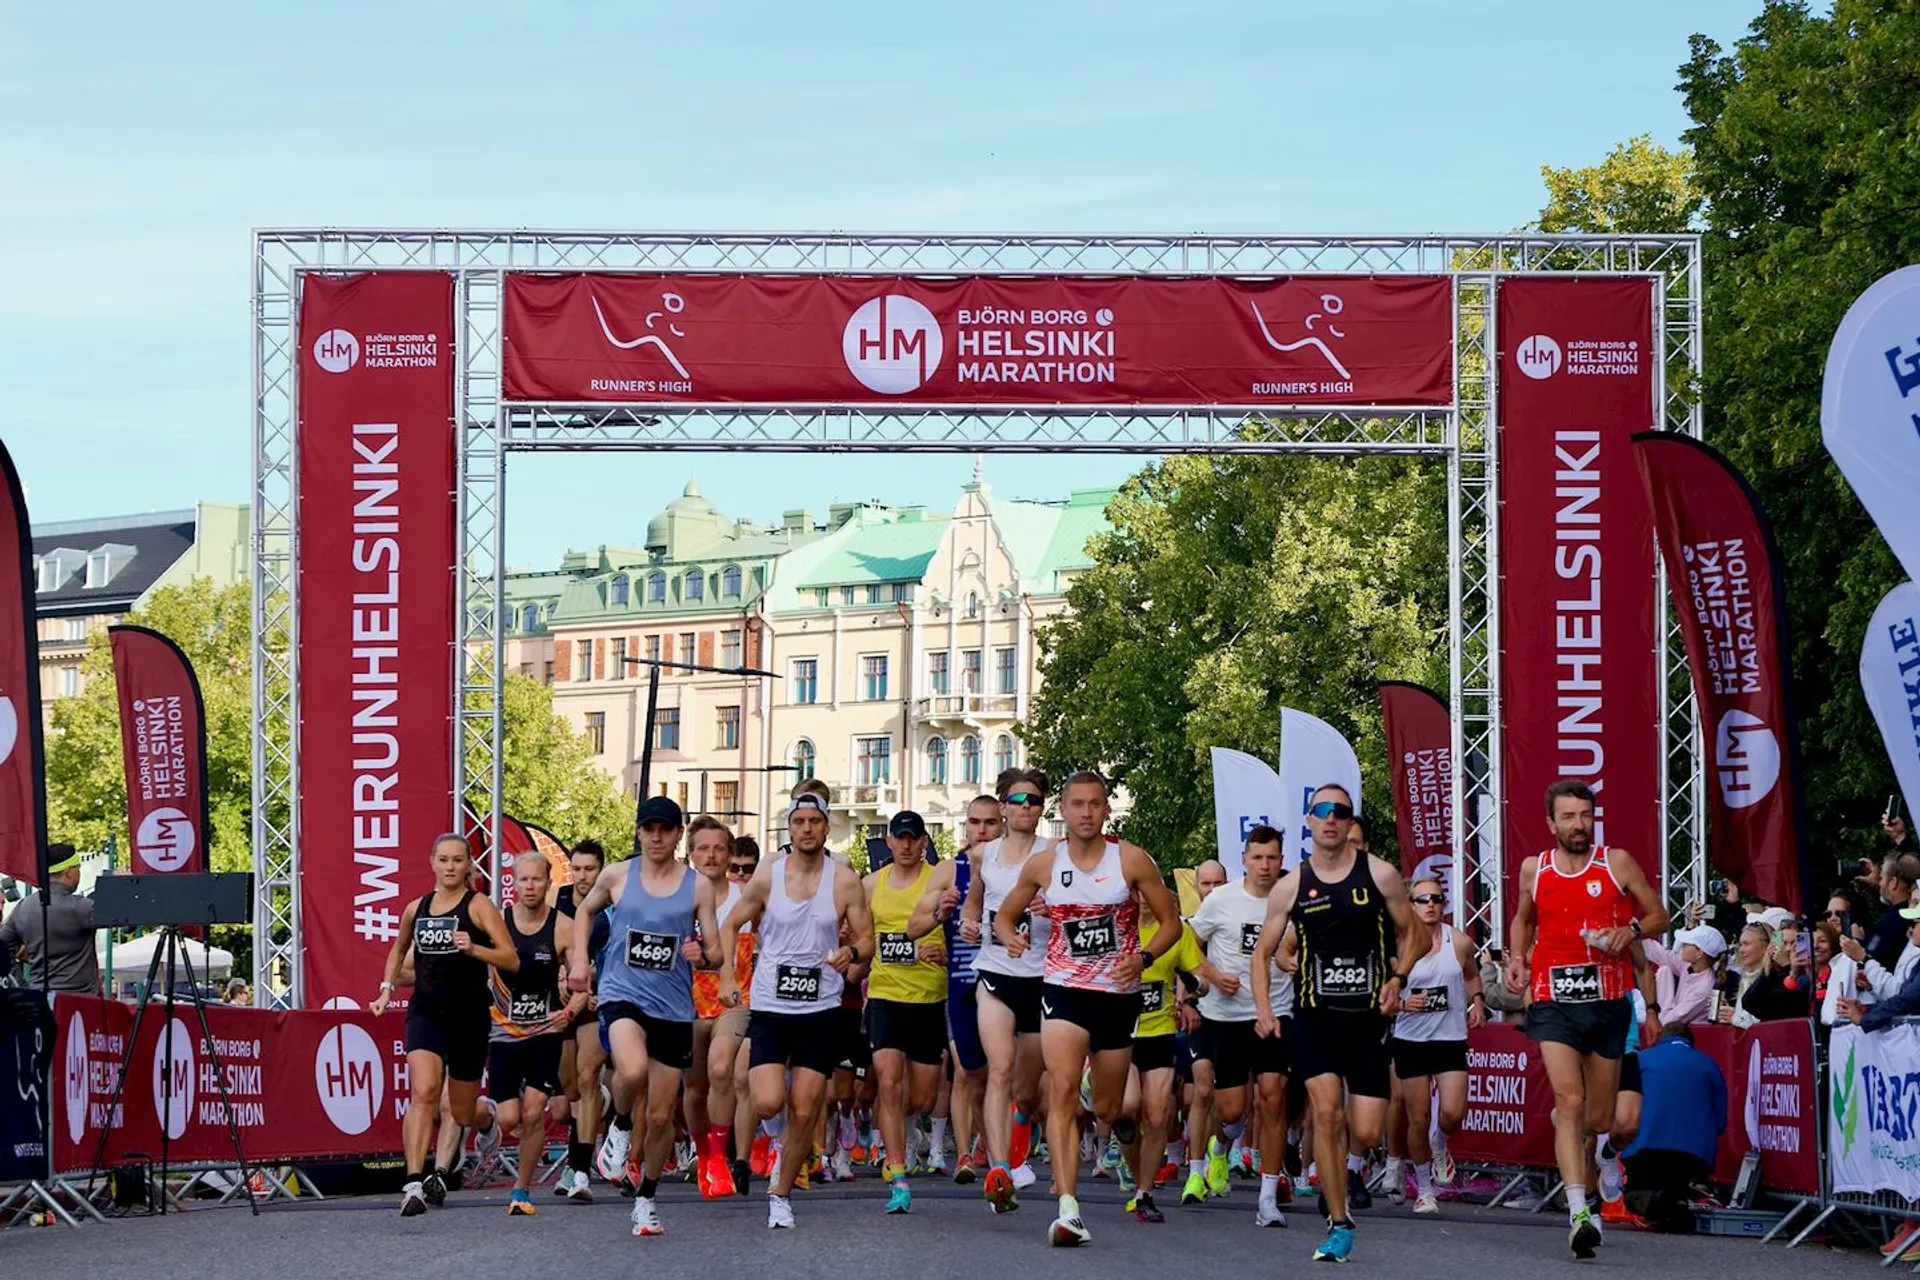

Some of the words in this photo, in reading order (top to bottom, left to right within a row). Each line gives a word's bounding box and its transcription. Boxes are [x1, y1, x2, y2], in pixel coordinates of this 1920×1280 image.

[958, 306, 1024, 325] BJÖRN
[1030, 310, 1087, 325] BORG
[365, 333, 396, 342] BJÖRN
[398, 334, 425, 342] BORG
[958, 330, 1115, 356] HELSINKI
[1567, 340, 1598, 349] BJÖRN
[1599, 341, 1626, 349] BORG
[365, 343, 437, 356] HELSINKI
[1567, 351, 1638, 363] HELSINKI
[365, 357, 437, 368] MARATHON
[958, 362, 1115, 382] MARATHON
[1567, 364, 1638, 375] MARATHON
[590, 379, 656, 392] RUNNER'S
[658, 380, 692, 393] HIGH
[1252, 382, 1318, 394] RUNNER'S
[1320, 381, 1354, 394] HIGH
[1689, 569, 1709, 624] BORG
[1697, 541, 1738, 694] HELSINKI
[1724, 538, 1761, 693] MARATHON
[352, 422, 400, 942] #WERUNHELSINKI
[136, 716, 150, 754] BORG
[147, 696, 171, 799] HELSINKI
[167, 695, 187, 797] MARATHON
[139, 757, 152, 800] BJÖRN
[1407, 767, 1420, 802] BORG
[1417, 749, 1443, 847] HELSINKI
[1412, 806, 1425, 848] BJÖRN
[502, 874, 514, 909] ORG
[419, 930, 452, 945] 2903
[1073, 927, 1109, 948] 4751
[631, 943, 672, 962] 4689
[882, 942, 913, 957] 2703
[779, 976, 817, 993] 2508
[1323, 967, 1366, 984] 2682
[1554, 975, 1597, 994] 3944
[513, 1000, 546, 1015] 2724
[229, 1040, 251, 1057] BORG
[1466, 1048, 1488, 1067] ÖRN
[1489, 1052, 1515, 1069] BORG
[1467, 1075, 1526, 1105] ELSINKI
[1761, 1083, 1800, 1118] HELSINKI
[1462, 1108, 1524, 1134] ARATHON
